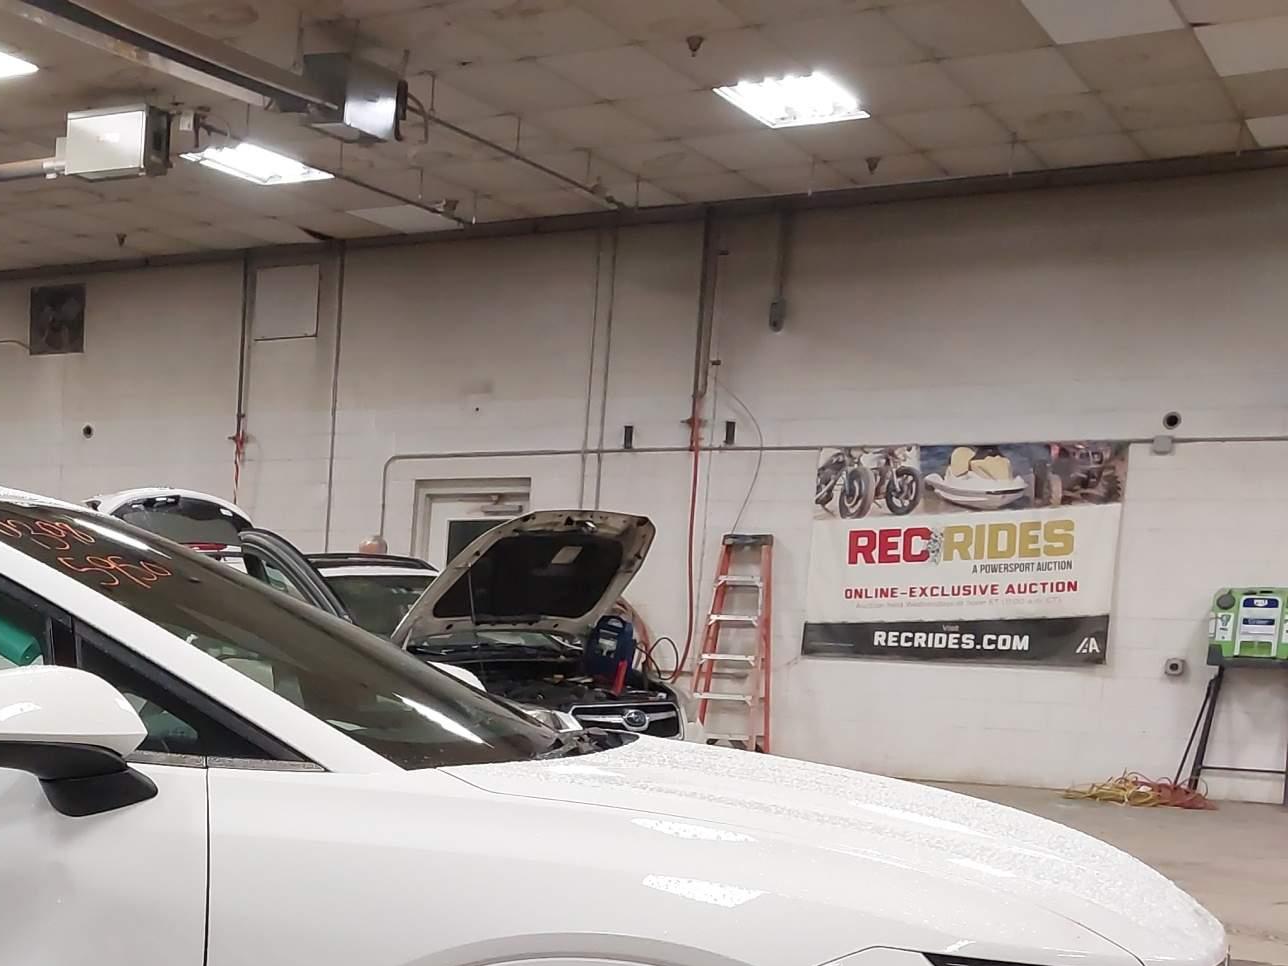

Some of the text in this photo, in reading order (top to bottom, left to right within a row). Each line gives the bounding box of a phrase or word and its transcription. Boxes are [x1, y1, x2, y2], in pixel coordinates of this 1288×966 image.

[847, 519, 1075, 565] REC RIDES
[57, 555, 172, 589] 5950
[972, 560, 1073, 574] A POWERSPORT AUCTION
[844, 580, 1079, 599] ONLINE-EXCLUSIVE AUCTION
[873, 631, 1030, 651] RECRIDES.COM
